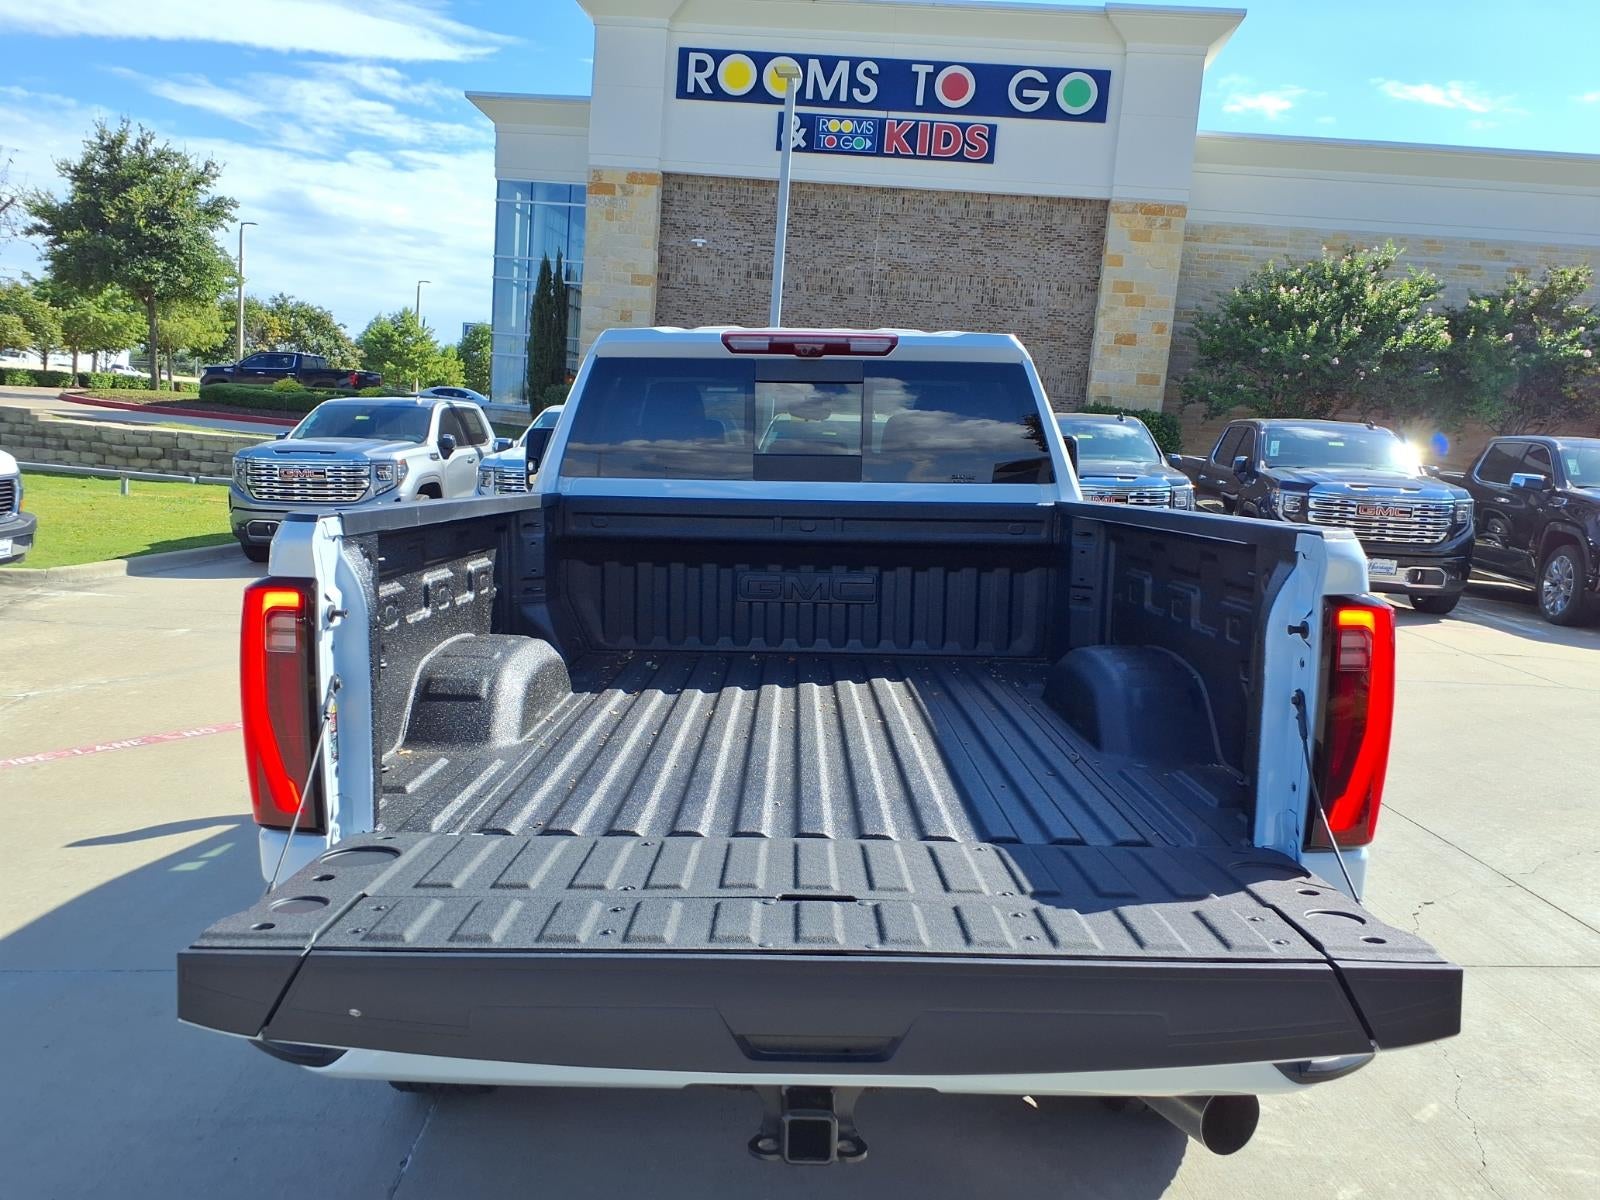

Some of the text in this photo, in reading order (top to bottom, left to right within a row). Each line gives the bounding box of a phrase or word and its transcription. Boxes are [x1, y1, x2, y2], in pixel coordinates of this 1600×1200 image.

[686, 52, 1099, 116] ROOMS TO GO
[819, 118, 874, 134] ROOMS
[819, 134, 866, 150] TO GO
[883, 119, 990, 160] KIDS
[280, 468, 326, 478] GMC
[1358, 505, 1412, 518] GMC
[738, 573, 876, 602] GMC
